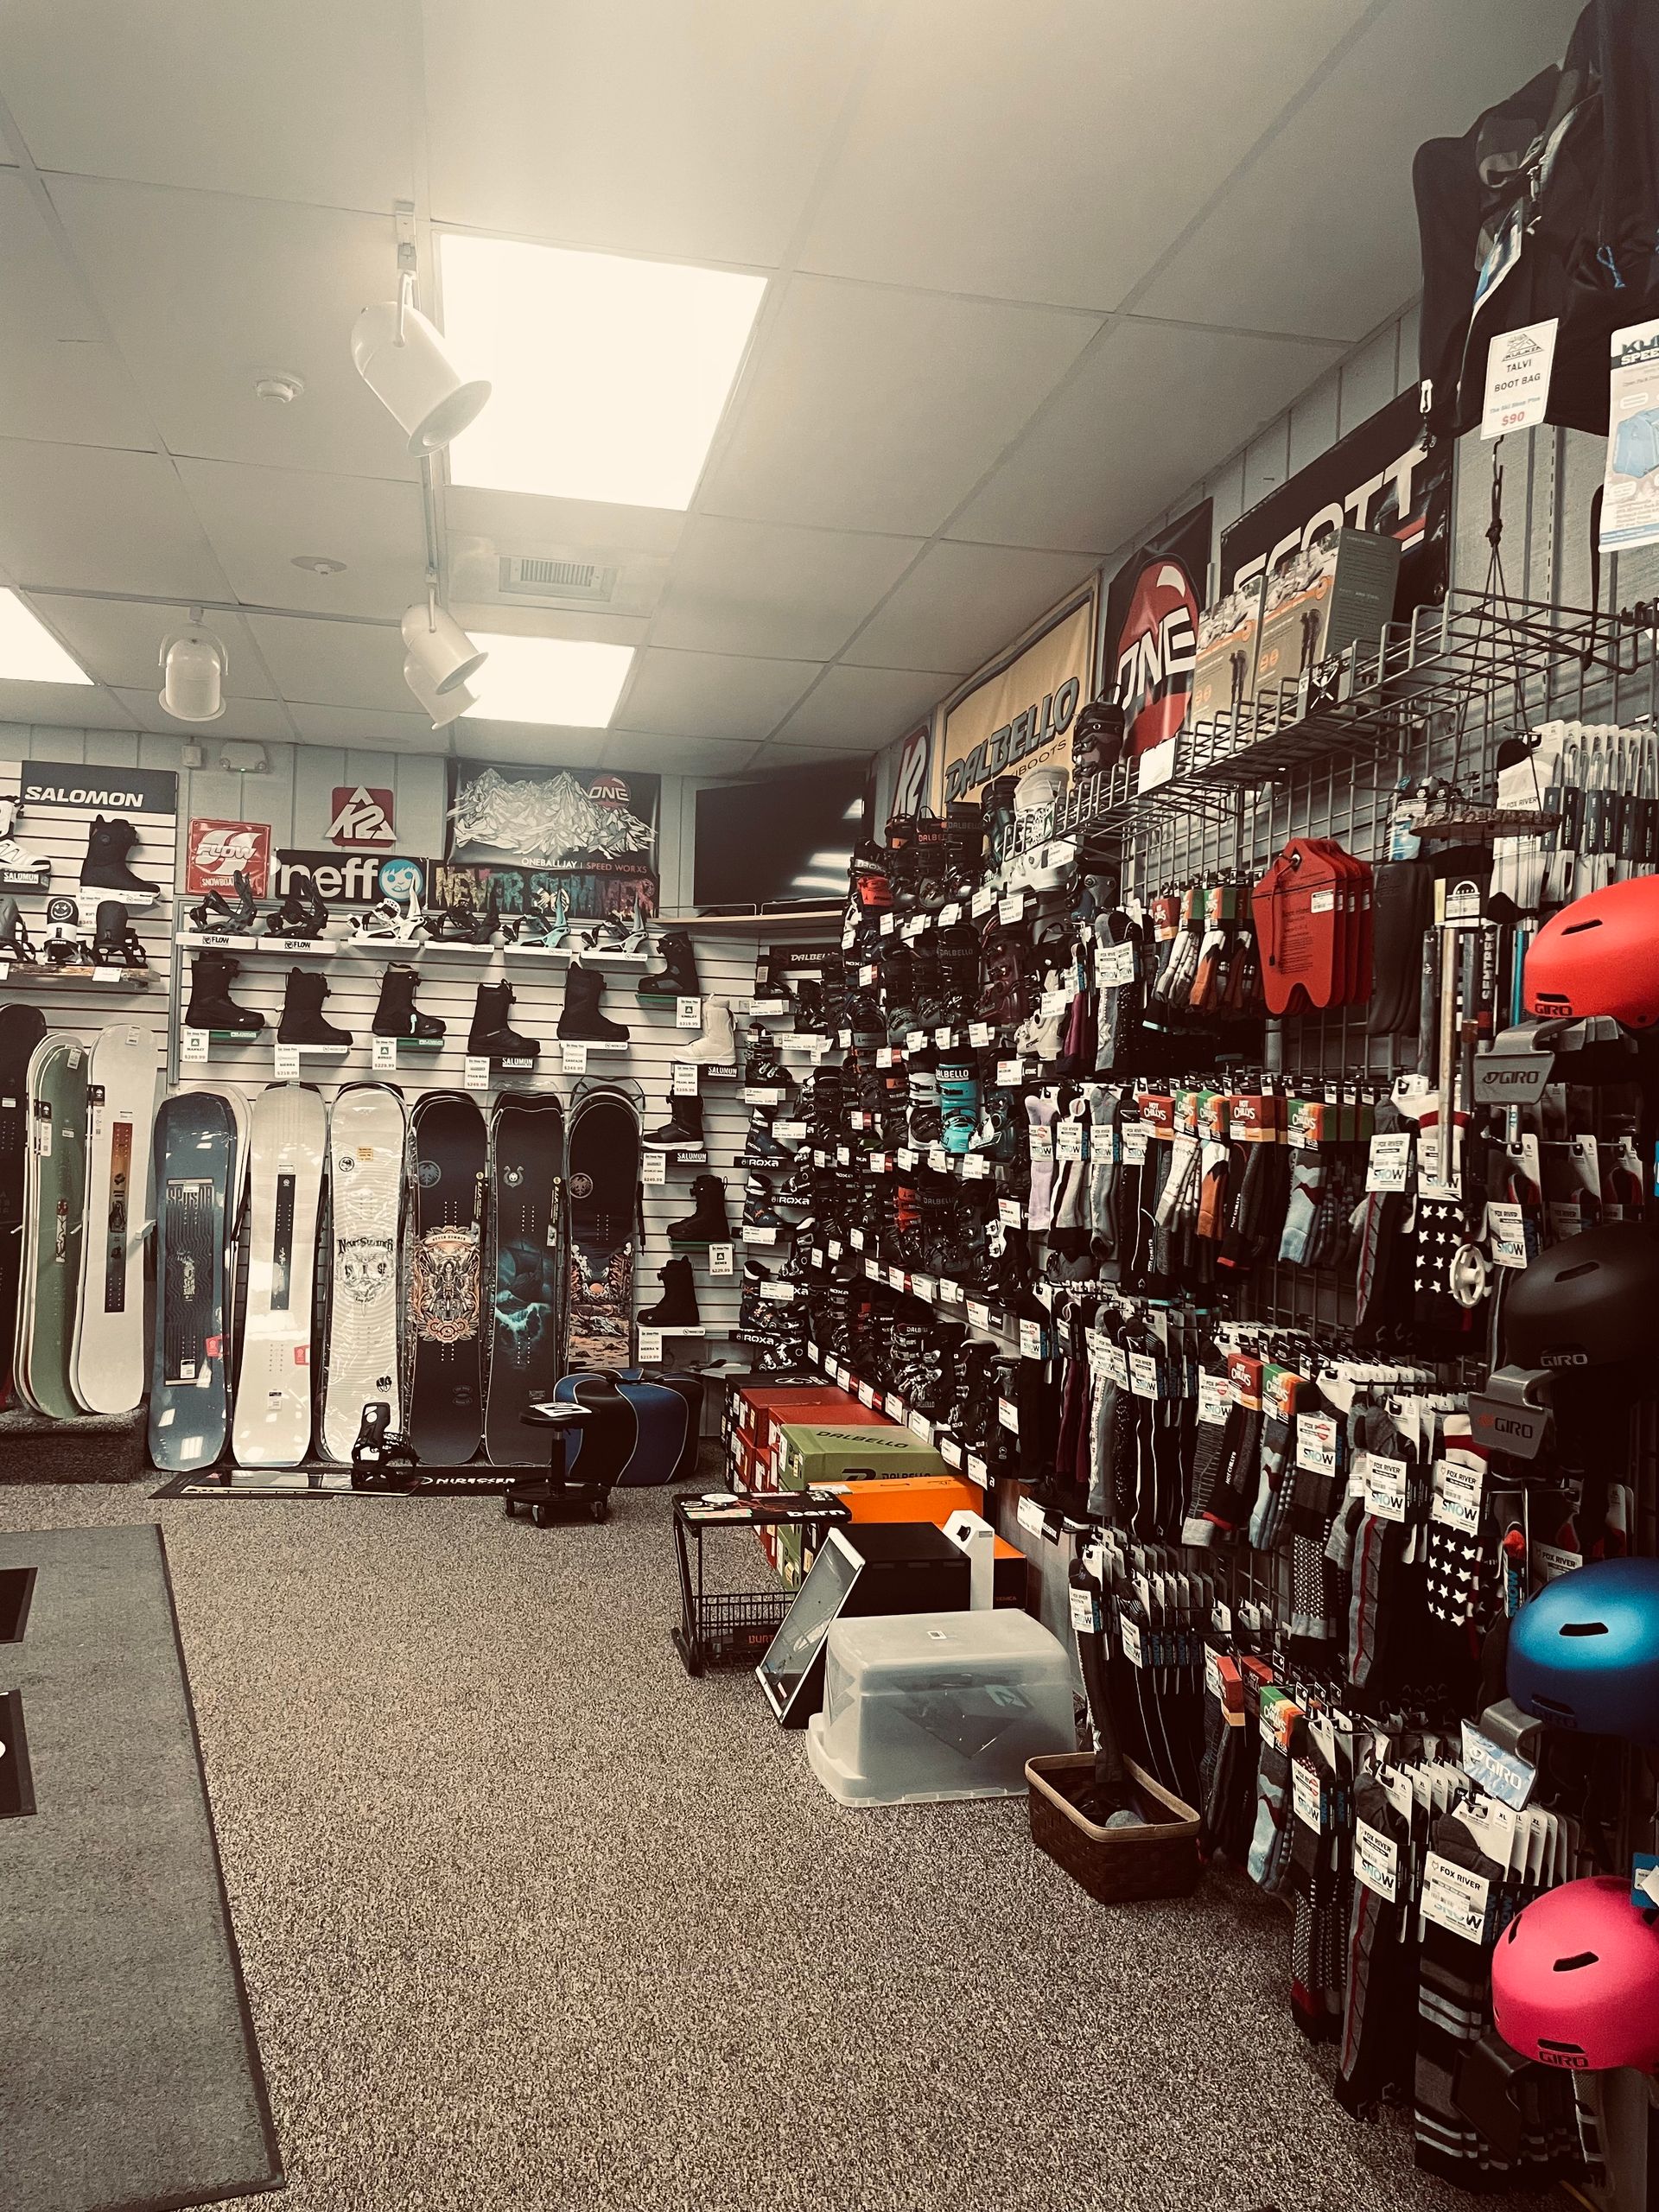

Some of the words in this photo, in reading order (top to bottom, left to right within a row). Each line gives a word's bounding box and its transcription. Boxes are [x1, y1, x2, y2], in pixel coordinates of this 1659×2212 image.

[1506, 359, 1532, 373] TALVI
[1494, 379, 1519, 392] BOOT
[1521, 372, 1541, 385] BAG
[1501, 411, 1525, 426] $90
[1113, 607, 1196, 711] ONE
[945, 677, 1080, 803] DALBELLO
[24, 785, 143, 808] SALOMON
[589, 785, 630, 802] ONE
[1506, 799, 1518, 809] FOX
[1519, 796, 1538, 806] RIVER
[327, 793, 397, 840] K2
[196, 843, 256, 860] FLOW
[521, 857, 577, 869] ONEBALLJAY
[586, 862, 613, 871] SPEED
[615, 864, 647, 874] WORXS
[3, 871, 39, 881] SALOMON
[200, 876, 252, 887] SNOWBOA
[280, 857, 378, 899] neff
[212, 936, 229, 944] FLOW
[294, 940, 311, 949] FLOW
[791, 953, 827, 962] DALBE
[1535, 1004, 1573, 1016] GIRO
[502, 1058, 533, 1066] SALOMON
[708, 1066, 737, 1075] SALOMON
[1499, 1071, 1539, 1084] GIRO
[1061, 1145, 1080, 1154] SNOW
[1096, 1148, 1112, 1157] SNOW
[1372, 1168, 1405, 1181] SNOW
[1497, 1242, 1524, 1256] SNOW
[1541, 1354, 1588, 1367] GIRO
[1136, 1380, 1156, 1391] SNOW
[1205, 1403, 1232, 1418] SNOW
[1305, 1421, 1313, 1430] FOX
[1495, 1417, 1533, 1439] GIRO
[816, 1430, 909, 1450] DALBELLO
[1303, 1447, 1334, 1465] SNOW
[1373, 1461, 1382, 1471] FOX
[1382, 1464, 1401, 1474] RIVER
[1446, 1469, 1459, 1478] FOX
[1459, 1473, 1477, 1484] RIVER
[1371, 1491, 1403, 1509] SNOW
[1442, 1499, 1477, 1522] SNOW
[748, 1635, 775, 1643] BURT
[1484, 1756, 1522, 1790] GIRO
[1297, 1796, 1319, 1822] SNOW
[1498, 1811, 1508, 1821] XL
[1532, 1816, 1541, 1827] XL
[1363, 1827, 1376, 1841] FOX
[1376, 1835, 1393, 1853] RIVER
[1361, 1859, 1395, 1890] SNOW
[1440, 1866, 1455, 1878] FOX
[1457, 1874, 1482, 1891] RIVER
[1539, 2051, 1589, 2069] GIRO
